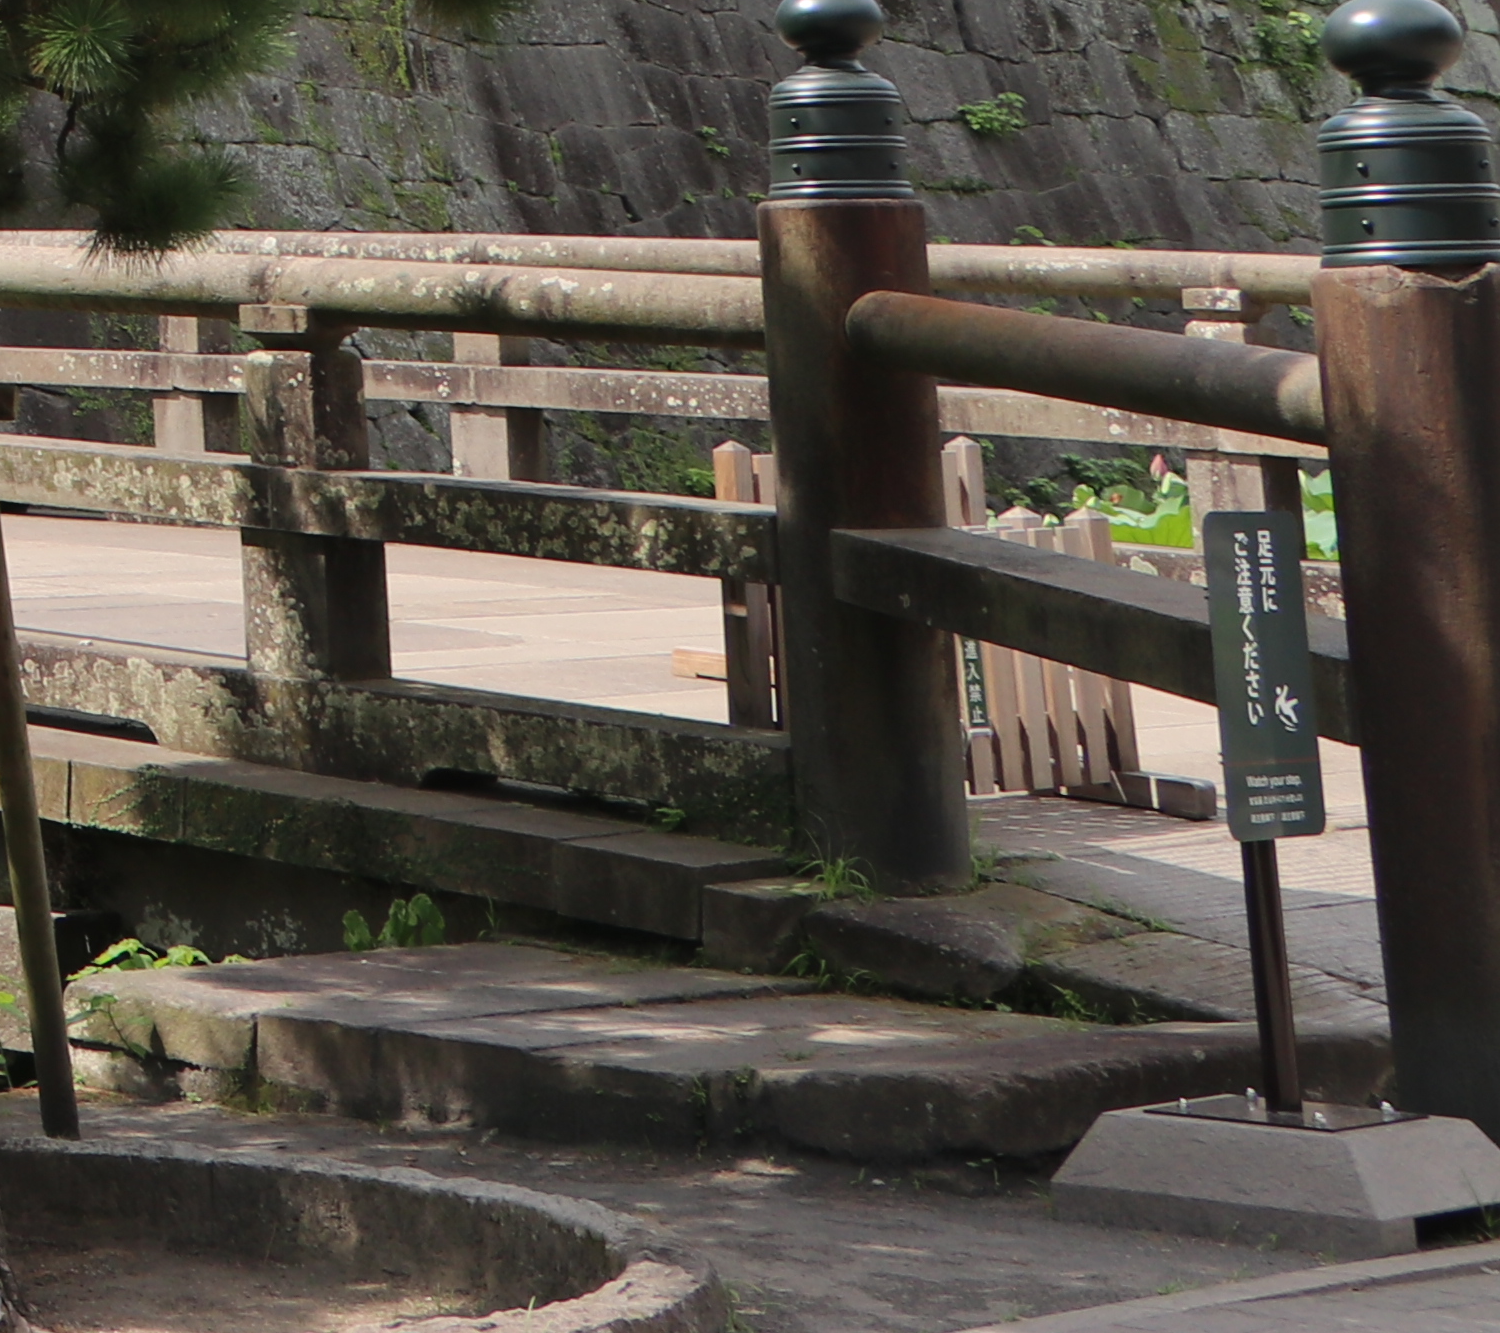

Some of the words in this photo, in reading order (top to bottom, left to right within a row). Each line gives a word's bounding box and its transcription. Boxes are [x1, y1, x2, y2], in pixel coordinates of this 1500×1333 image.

[1256, 529, 1279, 613] 足元に
[1233, 530, 1265, 727] ご注意ください
[964, 640, 986, 724] 進入禁止
[1245, 774, 1269, 788] Watch
